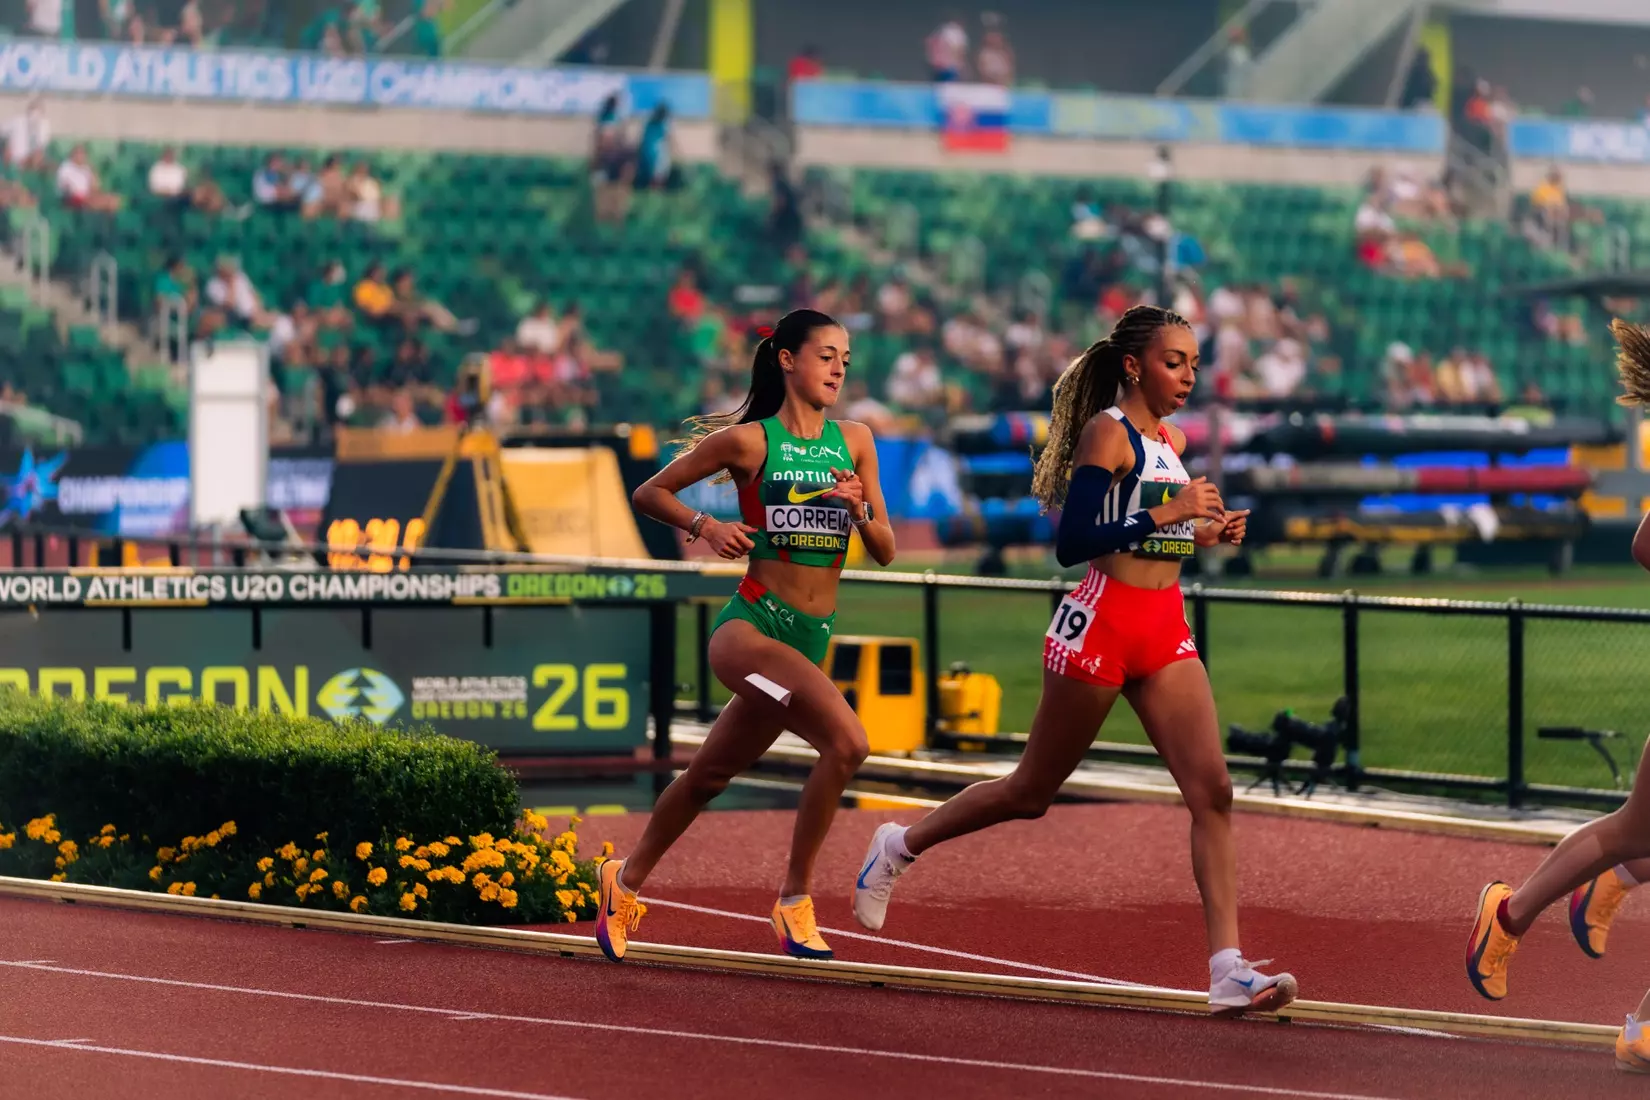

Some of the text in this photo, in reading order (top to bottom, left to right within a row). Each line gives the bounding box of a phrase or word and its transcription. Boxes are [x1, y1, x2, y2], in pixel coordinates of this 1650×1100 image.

[112, 50, 291, 96] ATHLETICS
[299, 57, 367, 102] U20
[773, 470, 838, 483] PORTUG
[772, 508, 849, 531] CORREIA
[1156, 518, 1194, 536] OURA
[789, 534, 840, 549] OREGON
[87, 575, 226, 600] ATHLETICS
[231, 574, 284, 600] U20
[289, 574, 500, 599] CHAMPIONSHIPS
[507, 574, 606, 598] OREGON
[634, 574, 667, 597] 26
[1055, 603, 1087, 641] 19
[412, 676, 460, 689] WORLD
[532, 663, 630, 731] 26
[411, 700, 528, 720] OREGON 26
